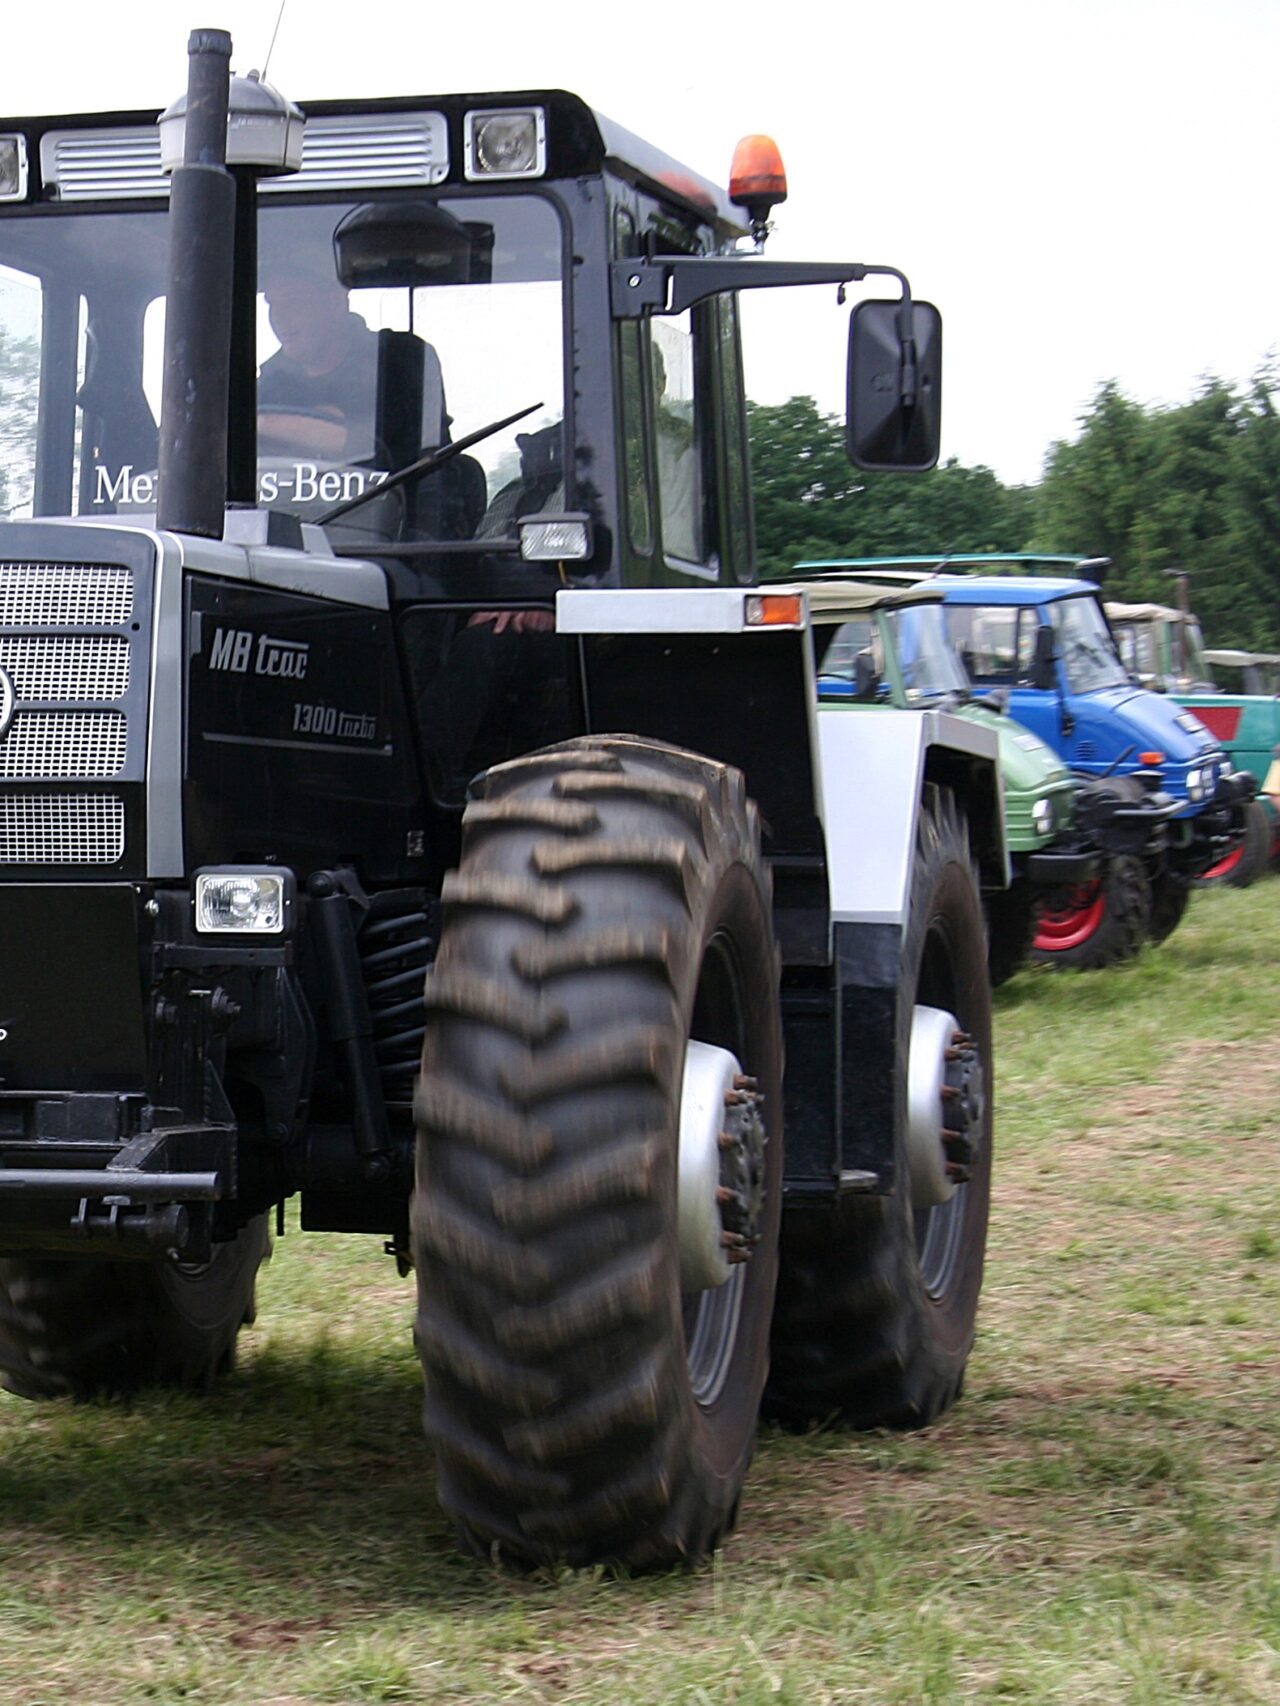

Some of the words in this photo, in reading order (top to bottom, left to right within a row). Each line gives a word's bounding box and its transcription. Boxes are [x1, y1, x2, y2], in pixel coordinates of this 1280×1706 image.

[209, 628, 253, 672] MB
[255, 634, 310, 679] trac
[293, 703, 337, 735] 1300
